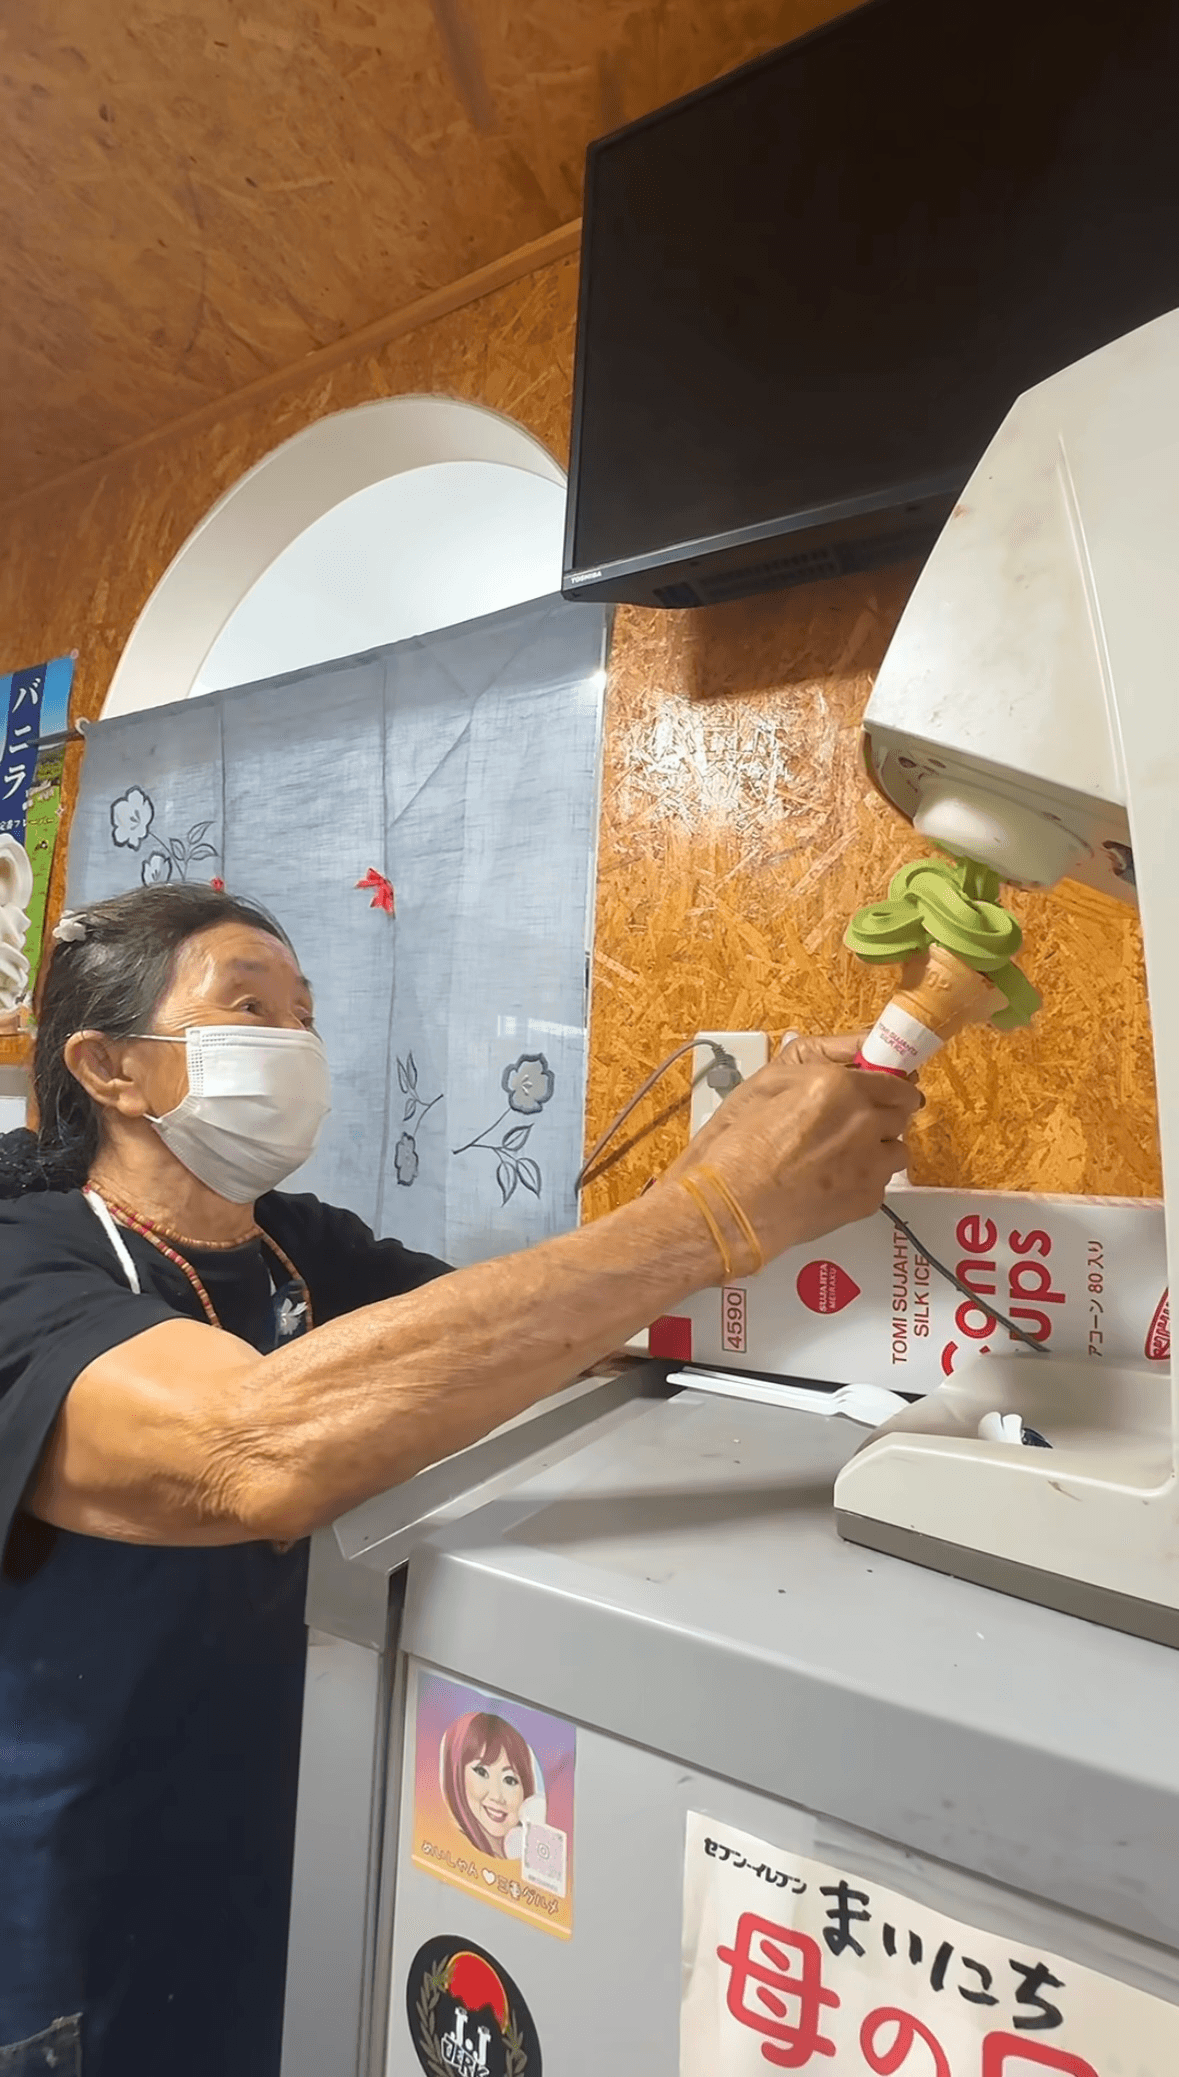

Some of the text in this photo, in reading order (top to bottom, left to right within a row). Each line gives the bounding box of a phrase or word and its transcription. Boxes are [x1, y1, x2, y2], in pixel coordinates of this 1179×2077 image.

[570, 570, 602, 584] TOSHIBA
[1, 677, 42, 800] バニラ
[818, 1263, 828, 1312] SUJAHTA
[913, 1253, 929, 1338] SILK ICE
[727, 1291, 743, 1349] 4590
[892, 1317, 908, 1365] TOMI
[819, 1879, 1066, 2031] まいにち
